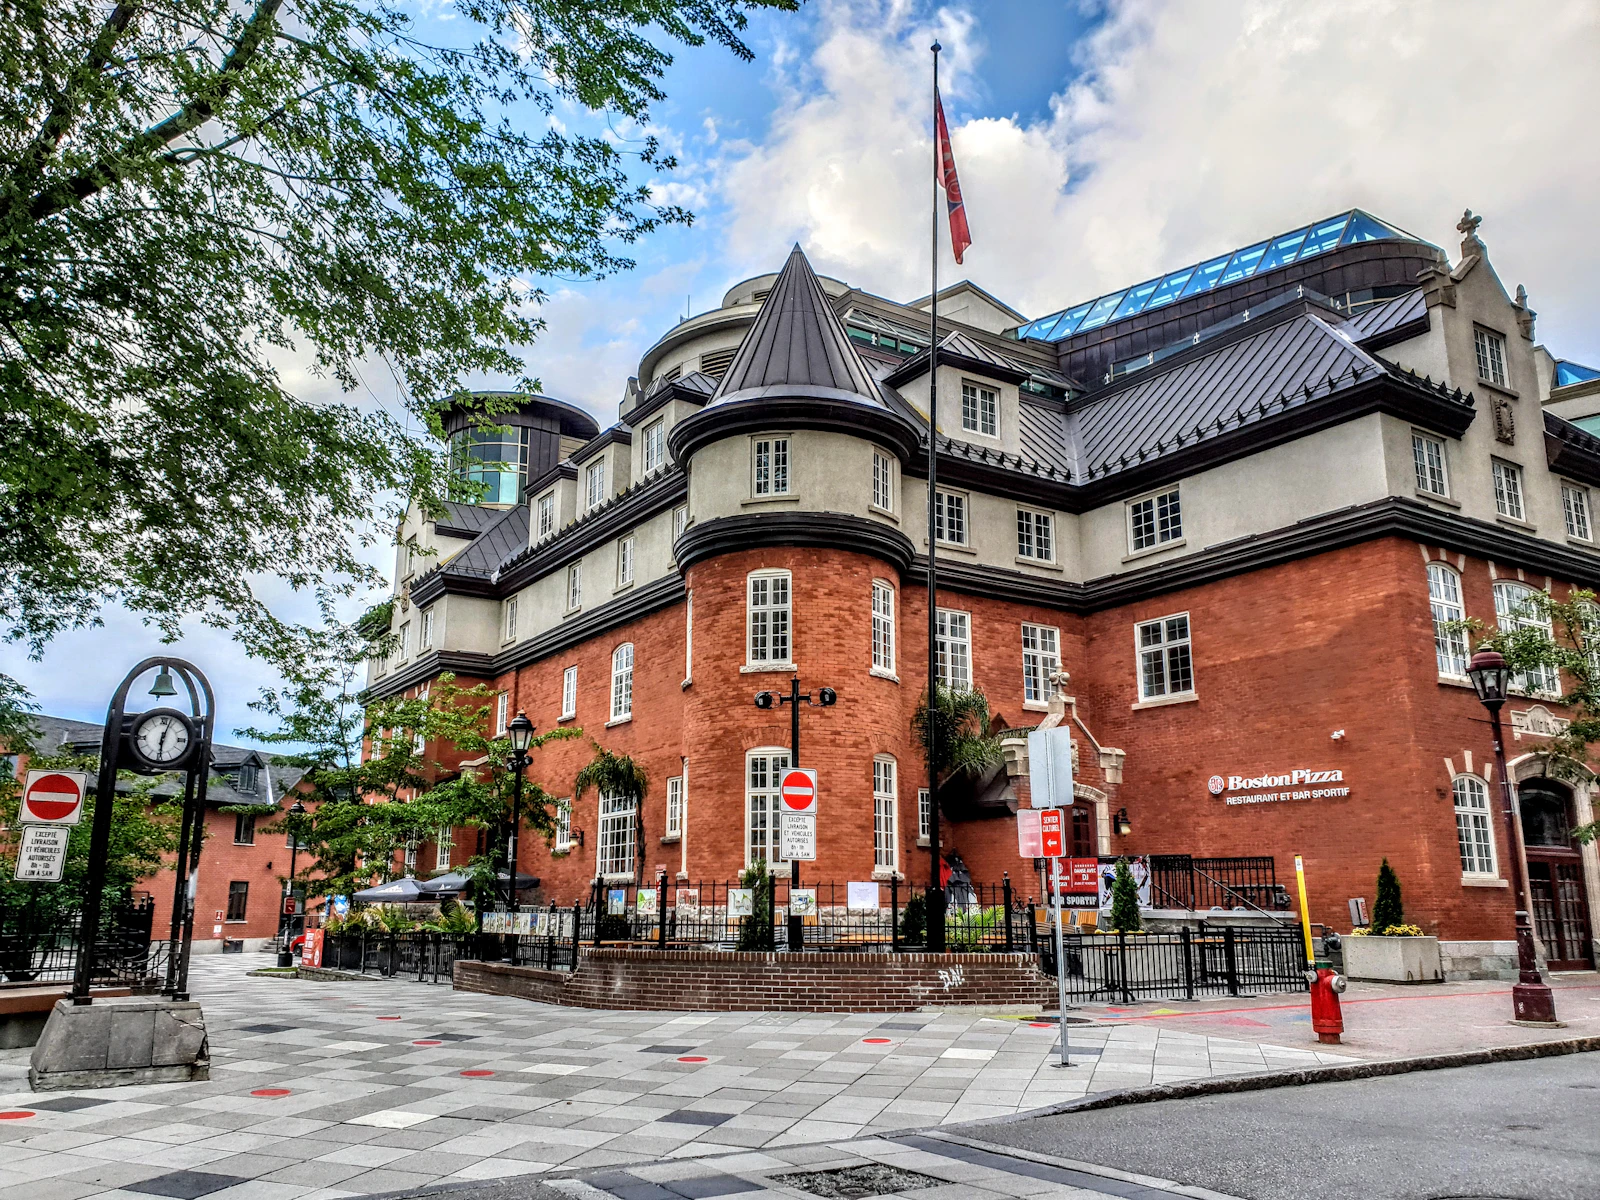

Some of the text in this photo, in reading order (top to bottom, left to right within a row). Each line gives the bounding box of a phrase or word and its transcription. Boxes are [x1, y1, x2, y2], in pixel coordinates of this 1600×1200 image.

[1227, 768, 1344, 790] Boston Pizza
[1226, 787, 1350, 805] RESTAURANT ET BAR SPORTIF
[1051, 896, 1097, 905] BR SPORTIF
